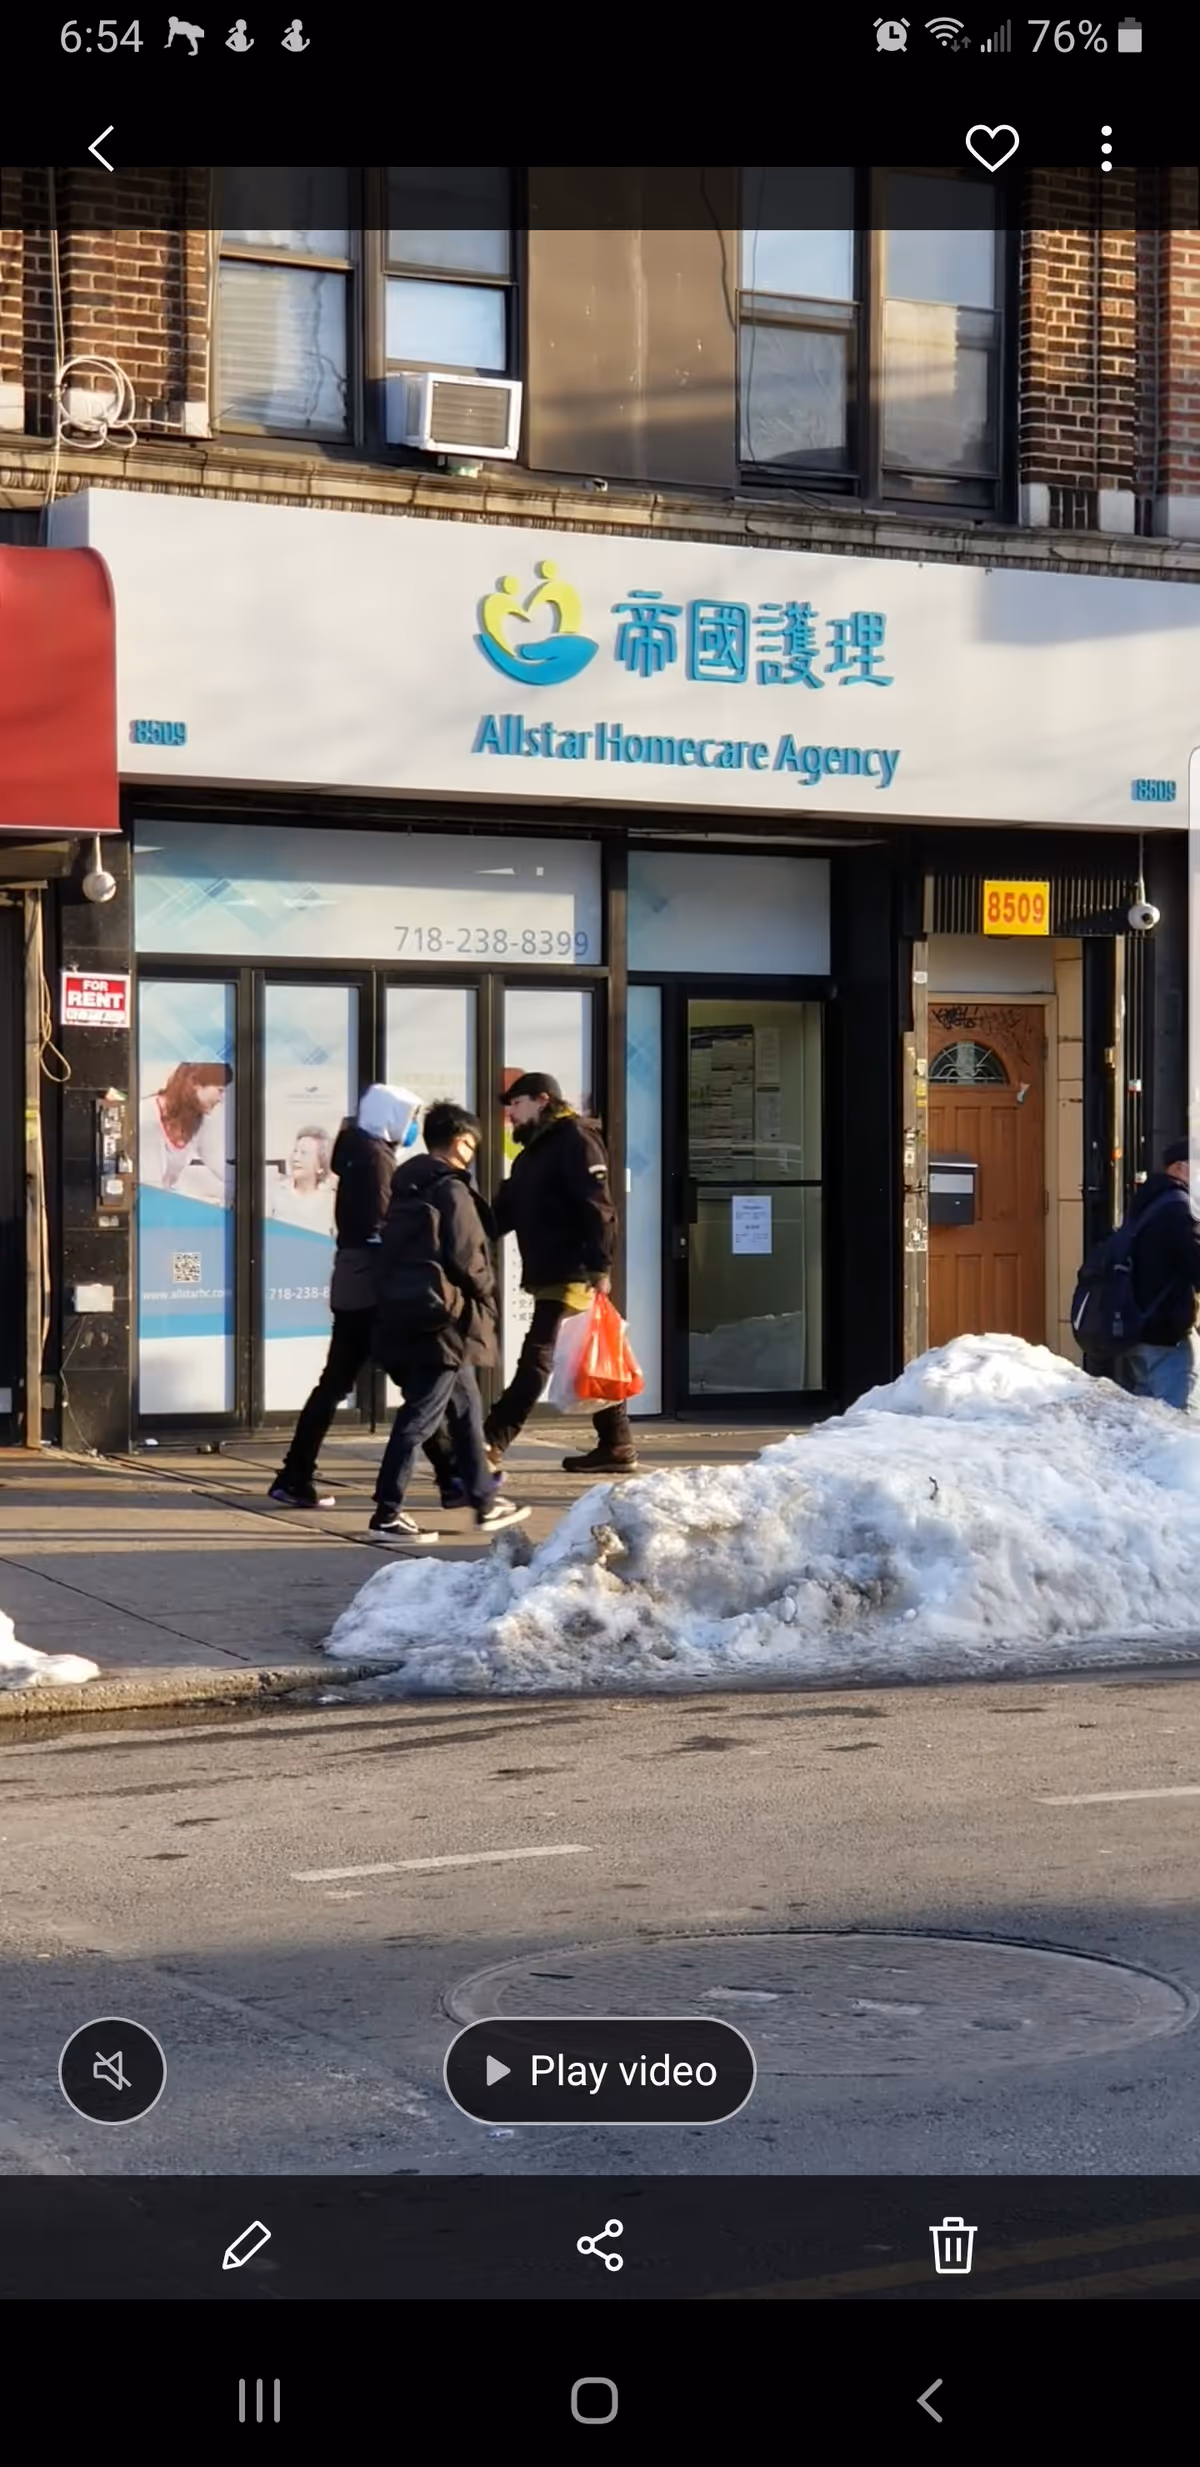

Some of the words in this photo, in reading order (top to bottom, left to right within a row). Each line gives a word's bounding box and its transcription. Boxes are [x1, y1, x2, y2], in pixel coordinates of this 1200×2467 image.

[611, 589, 895, 689] 帝國護理
[129, 719, 187, 746] 8509
[471, 714, 592, 760] Allstar
[594, 721, 769, 771] Homecare
[772, 733, 900, 789] Agency
[1131, 778, 1177, 802] 8509
[986, 891, 1045, 925] 8509
[394, 926, 589, 957] 718-238-8399
[67, 989, 124, 1009] RENT
[83, 979, 109, 992] FOR
